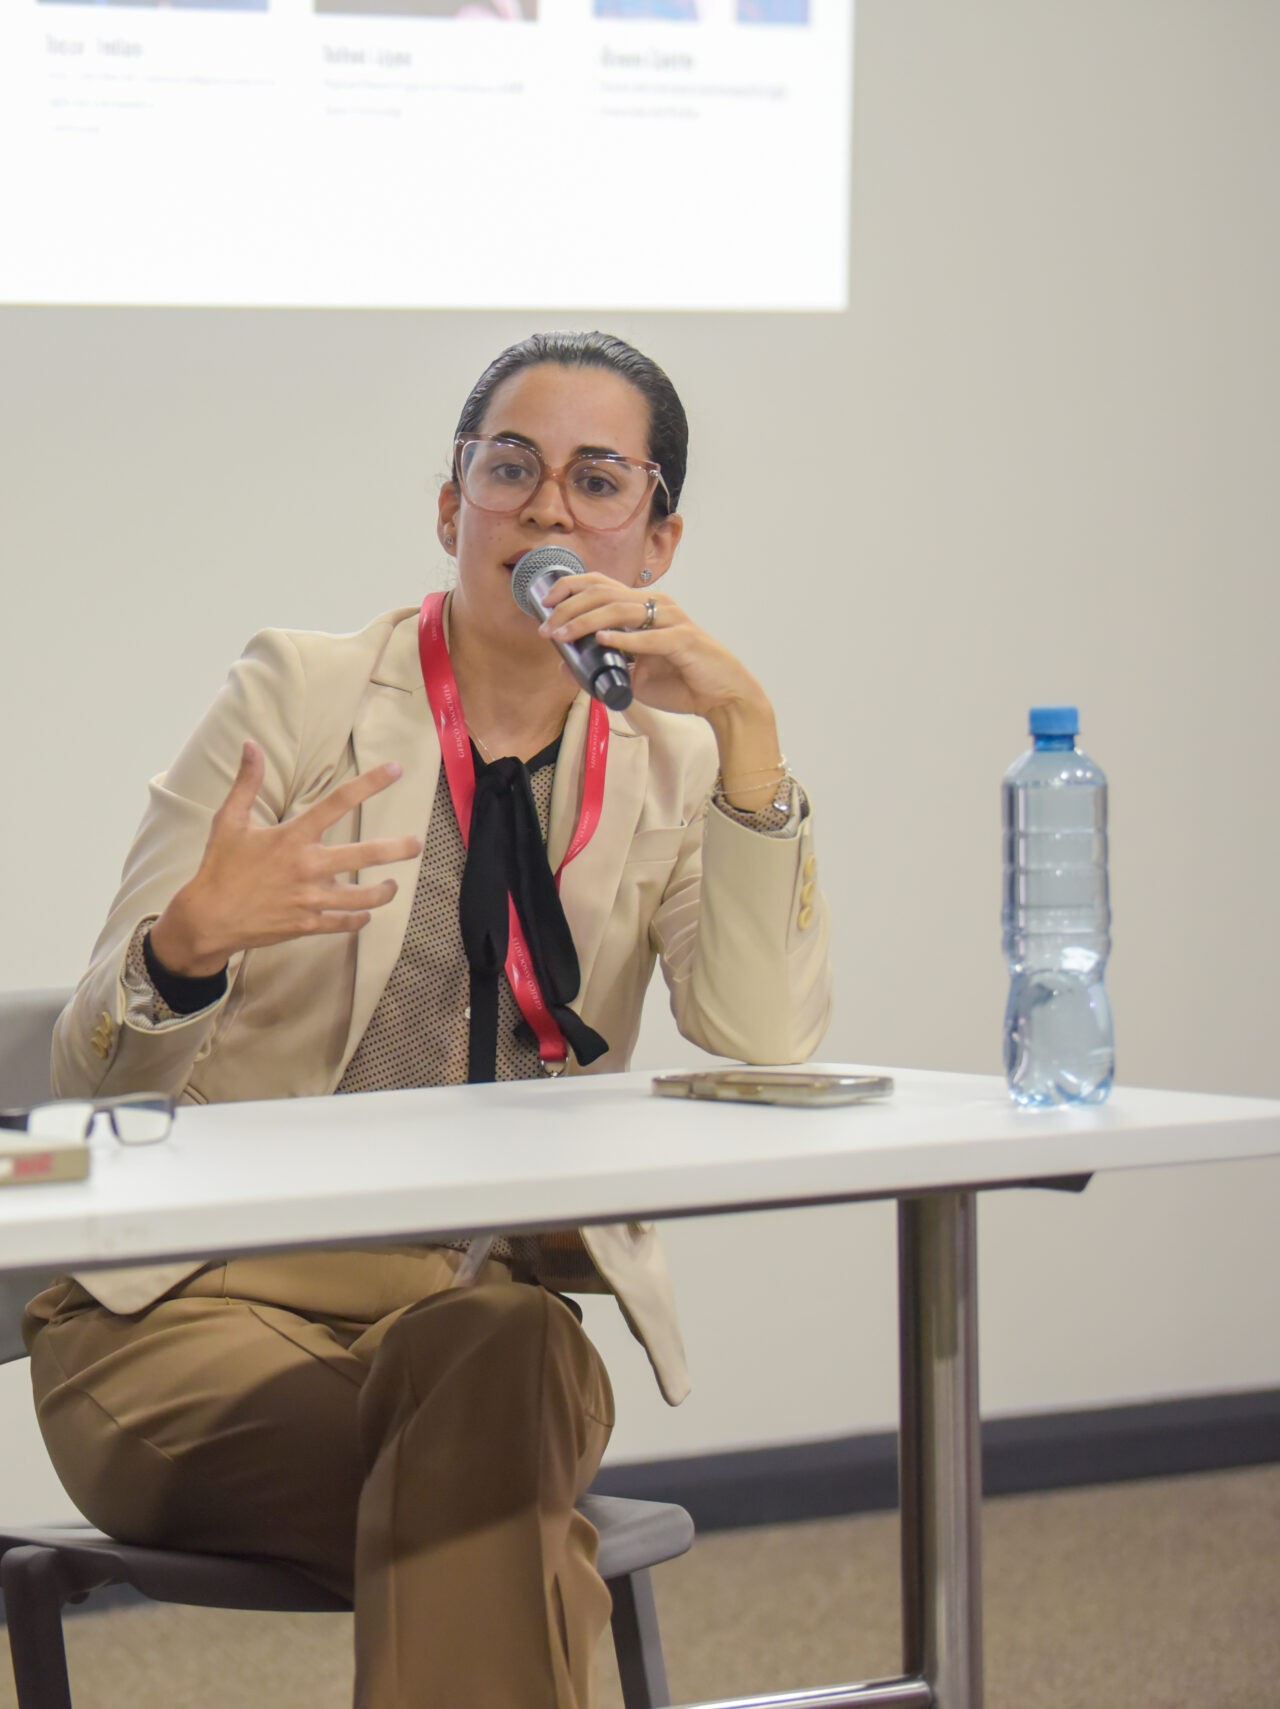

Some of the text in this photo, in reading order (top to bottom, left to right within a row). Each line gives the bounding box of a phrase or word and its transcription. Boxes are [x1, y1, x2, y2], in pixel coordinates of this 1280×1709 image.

[442, 684, 465, 759] GERICO ASSOCIATES
[528, 980, 543, 1010] GERICO
